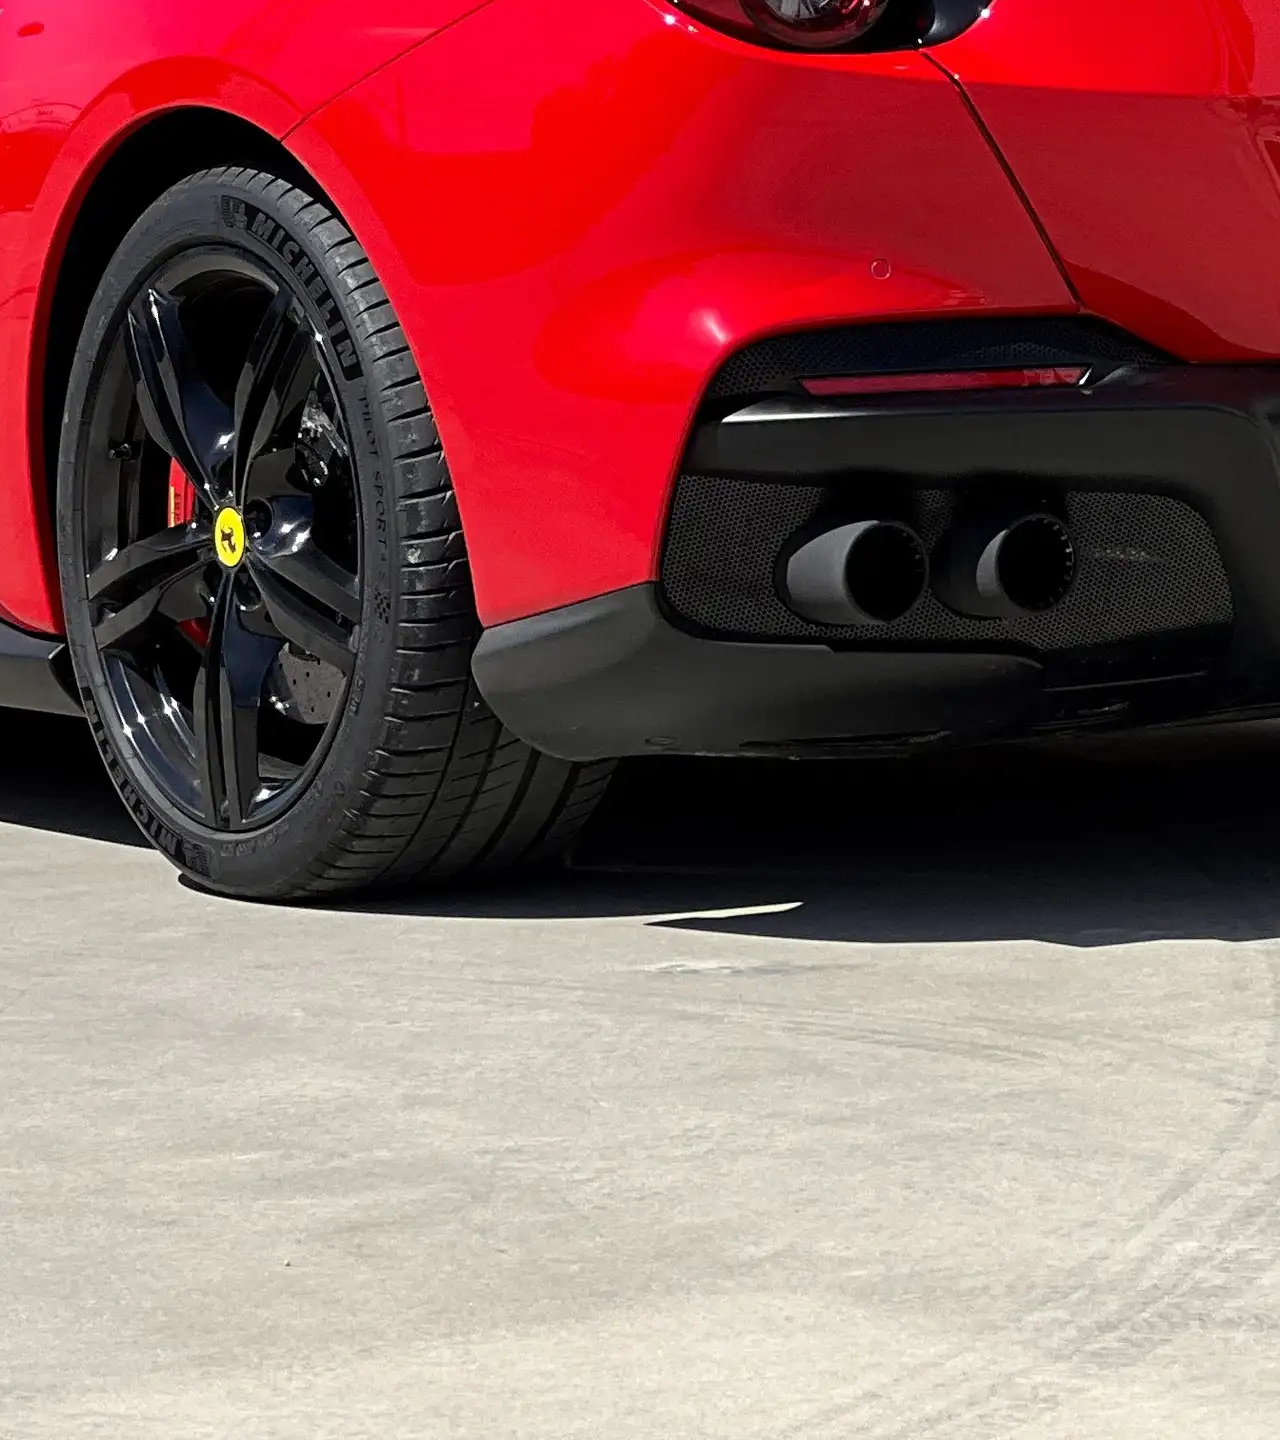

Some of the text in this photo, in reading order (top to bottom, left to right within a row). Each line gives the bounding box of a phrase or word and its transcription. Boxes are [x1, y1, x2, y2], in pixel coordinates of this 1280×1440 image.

[250, 211, 358, 369] MICHELIN
[359, 396, 378, 457] PILOT
[372, 470, 388, 550] SPORT
[84, 699, 179, 857] MICHELIN
